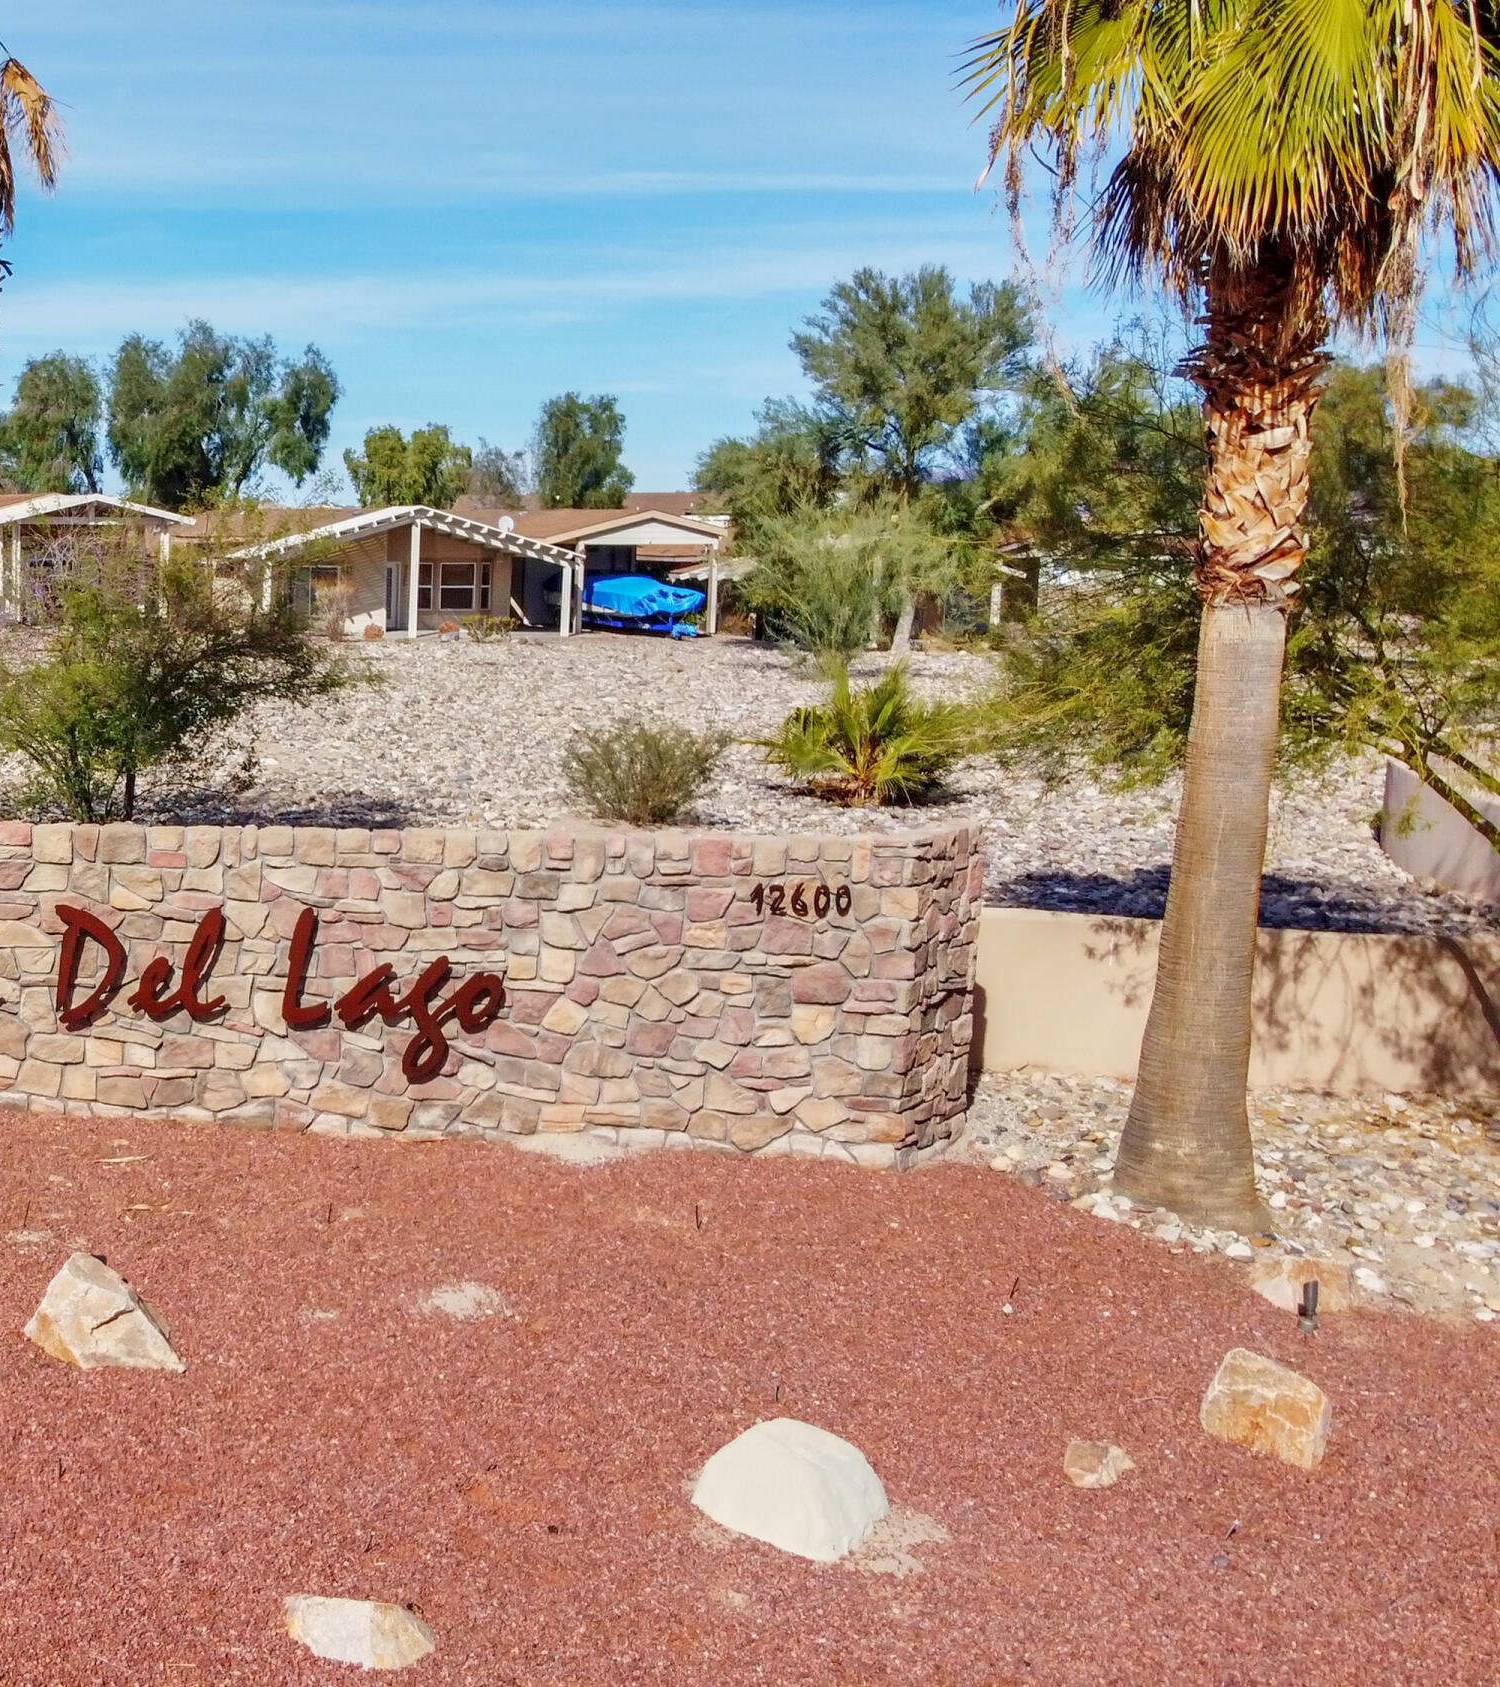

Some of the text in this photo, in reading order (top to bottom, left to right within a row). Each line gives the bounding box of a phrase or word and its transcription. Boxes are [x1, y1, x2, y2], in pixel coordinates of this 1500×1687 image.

[750, 882, 852, 918] 12600
[55, 904, 226, 1025] Del
[282, 907, 507, 1083] Lago
